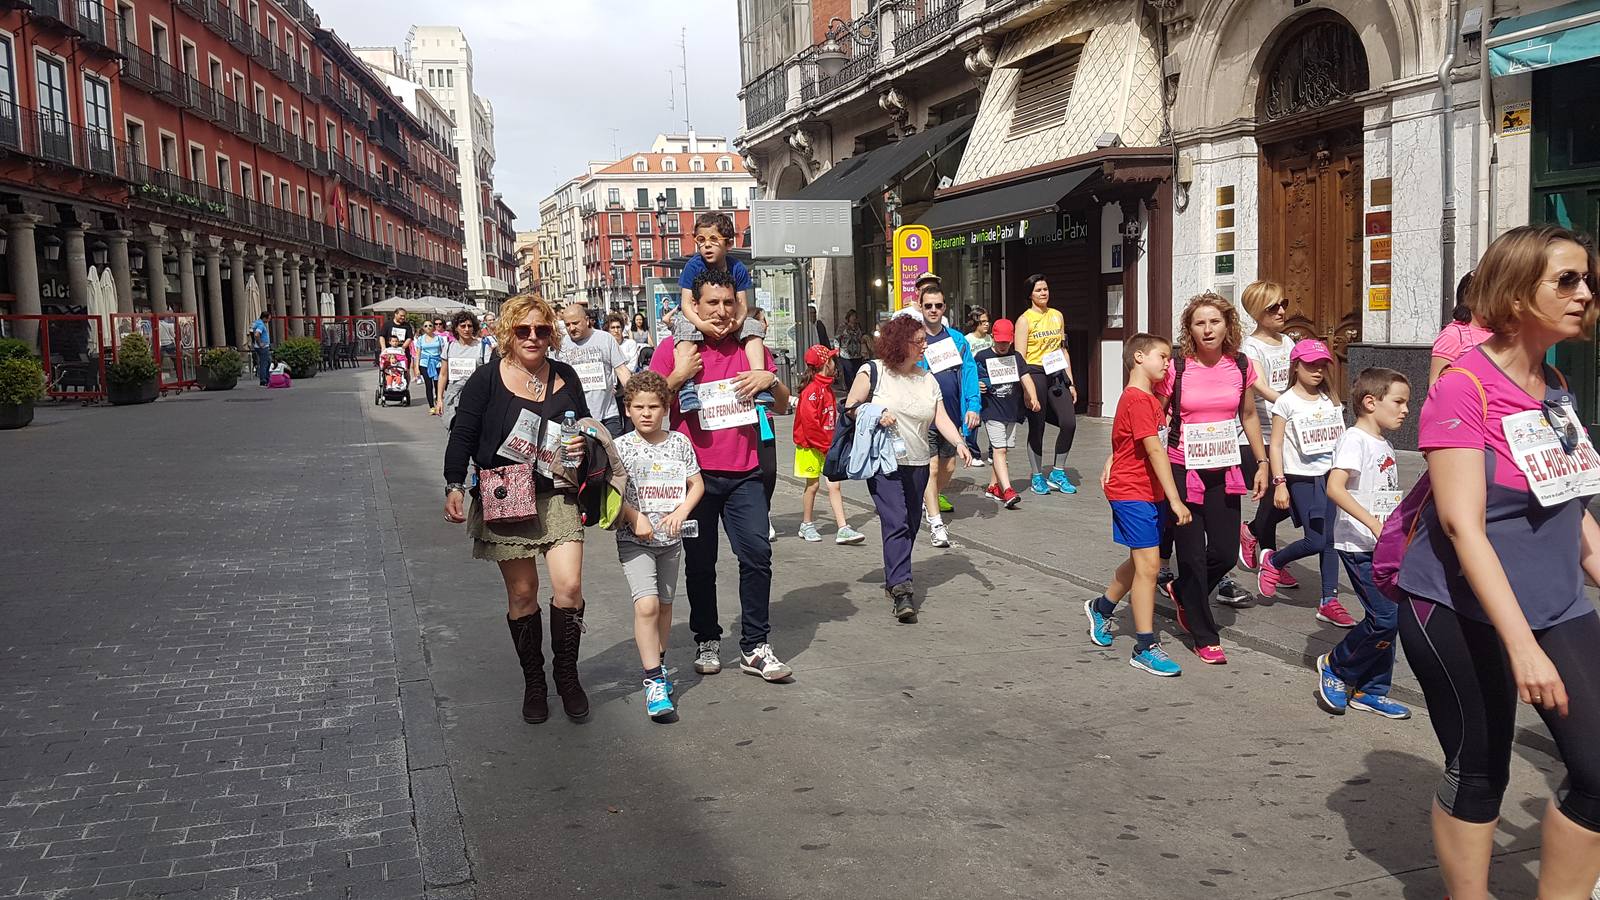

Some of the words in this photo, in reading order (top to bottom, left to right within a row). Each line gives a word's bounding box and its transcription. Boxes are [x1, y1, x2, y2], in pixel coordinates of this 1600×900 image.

[909, 236, 918, 249] 8
[902, 263, 918, 272] bus
[702, 407, 715, 420] DIEZ
[507, 436, 528, 453] DIEZ
[1301, 431, 1311, 445] EL
[1310, 427, 1328, 443] HUEVO
[1187, 442, 1208, 458] PUCELA
[1208, 441, 1217, 457] EN
[1524, 453, 1548, 482] EL
[644, 482, 684, 500] FERNÁNDEZ?
